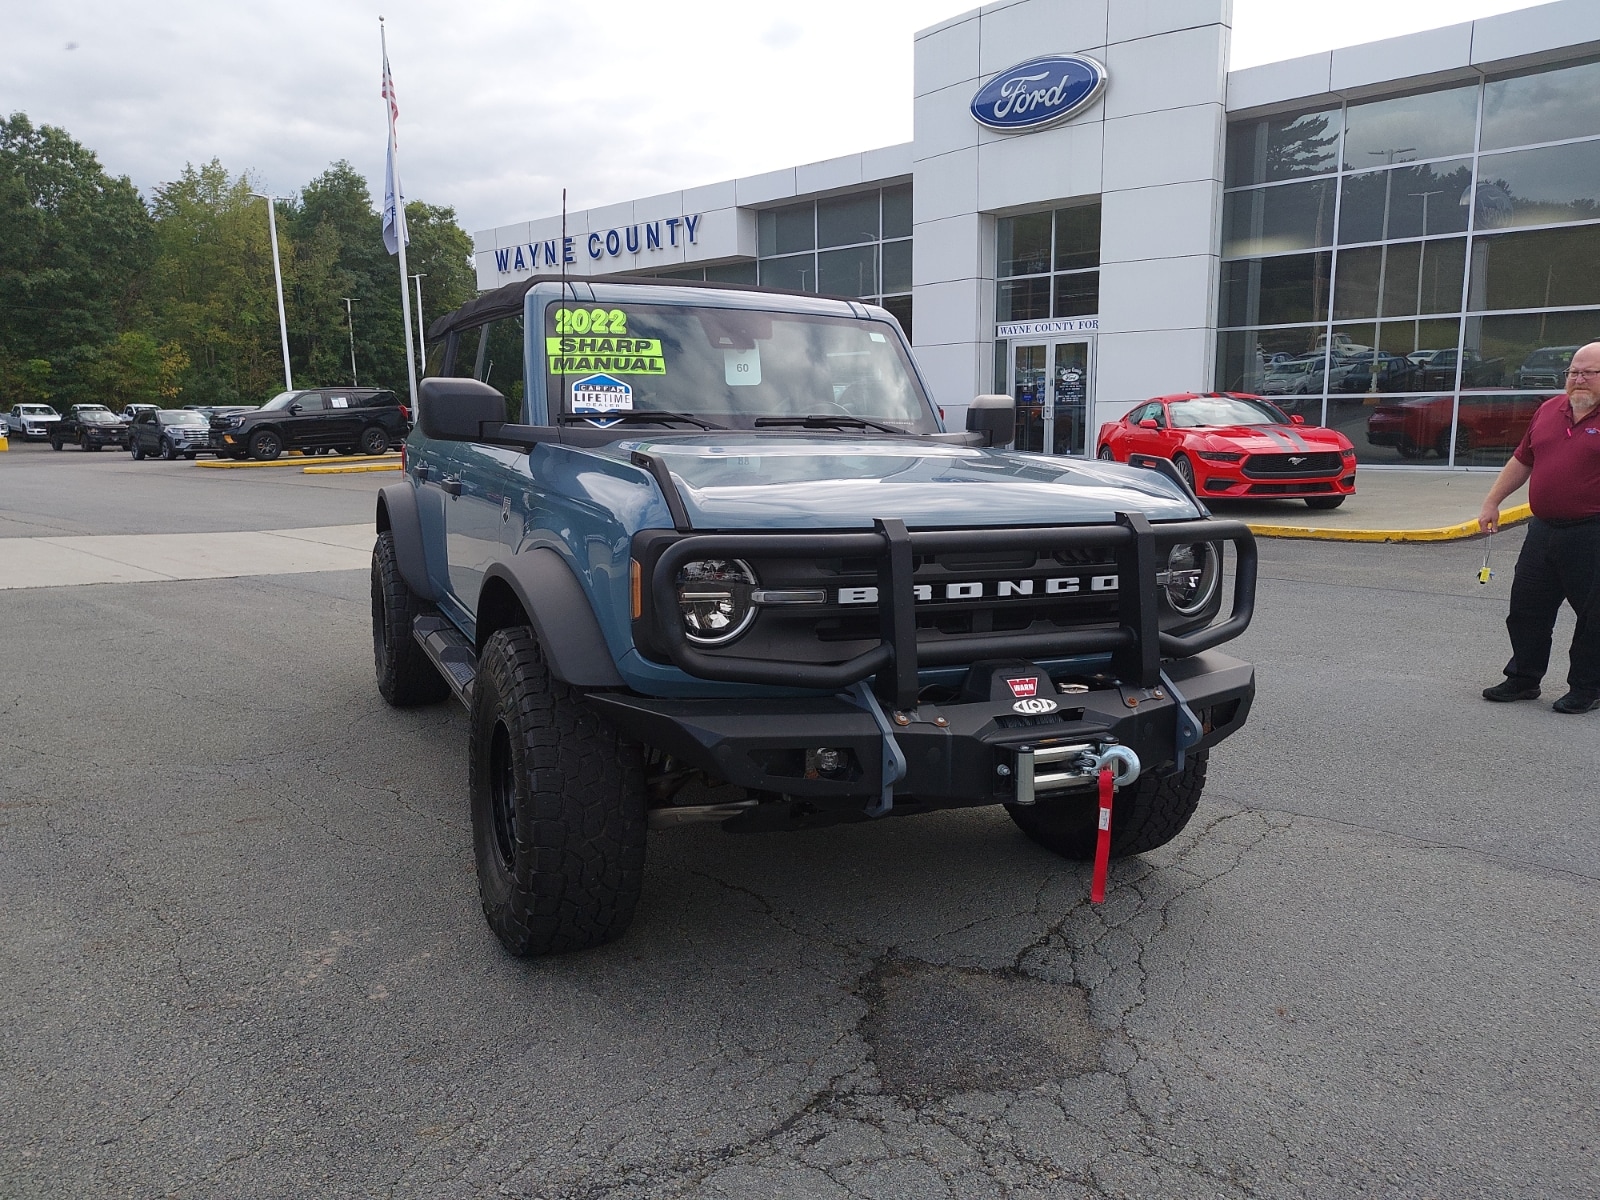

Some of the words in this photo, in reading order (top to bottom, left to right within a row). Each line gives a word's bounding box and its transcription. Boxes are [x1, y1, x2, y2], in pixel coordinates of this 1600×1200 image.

[993, 71, 1069, 118] Ford
[494, 237, 577, 274] WAYNE
[587, 214, 703, 260] COUNTY
[555, 308, 627, 334] 2022
[1000, 323, 1032, 335] WAYNE
[1035, 321, 1075, 332] COUNTY
[558, 338, 654, 354] SHARP
[553, 356, 665, 373] MANUAL
[736, 363, 749, 373] 60
[579, 384, 625, 393] CARFAX
[574, 393, 631, 403] LIFETIME
[1013, 683, 1035, 692] WARN
